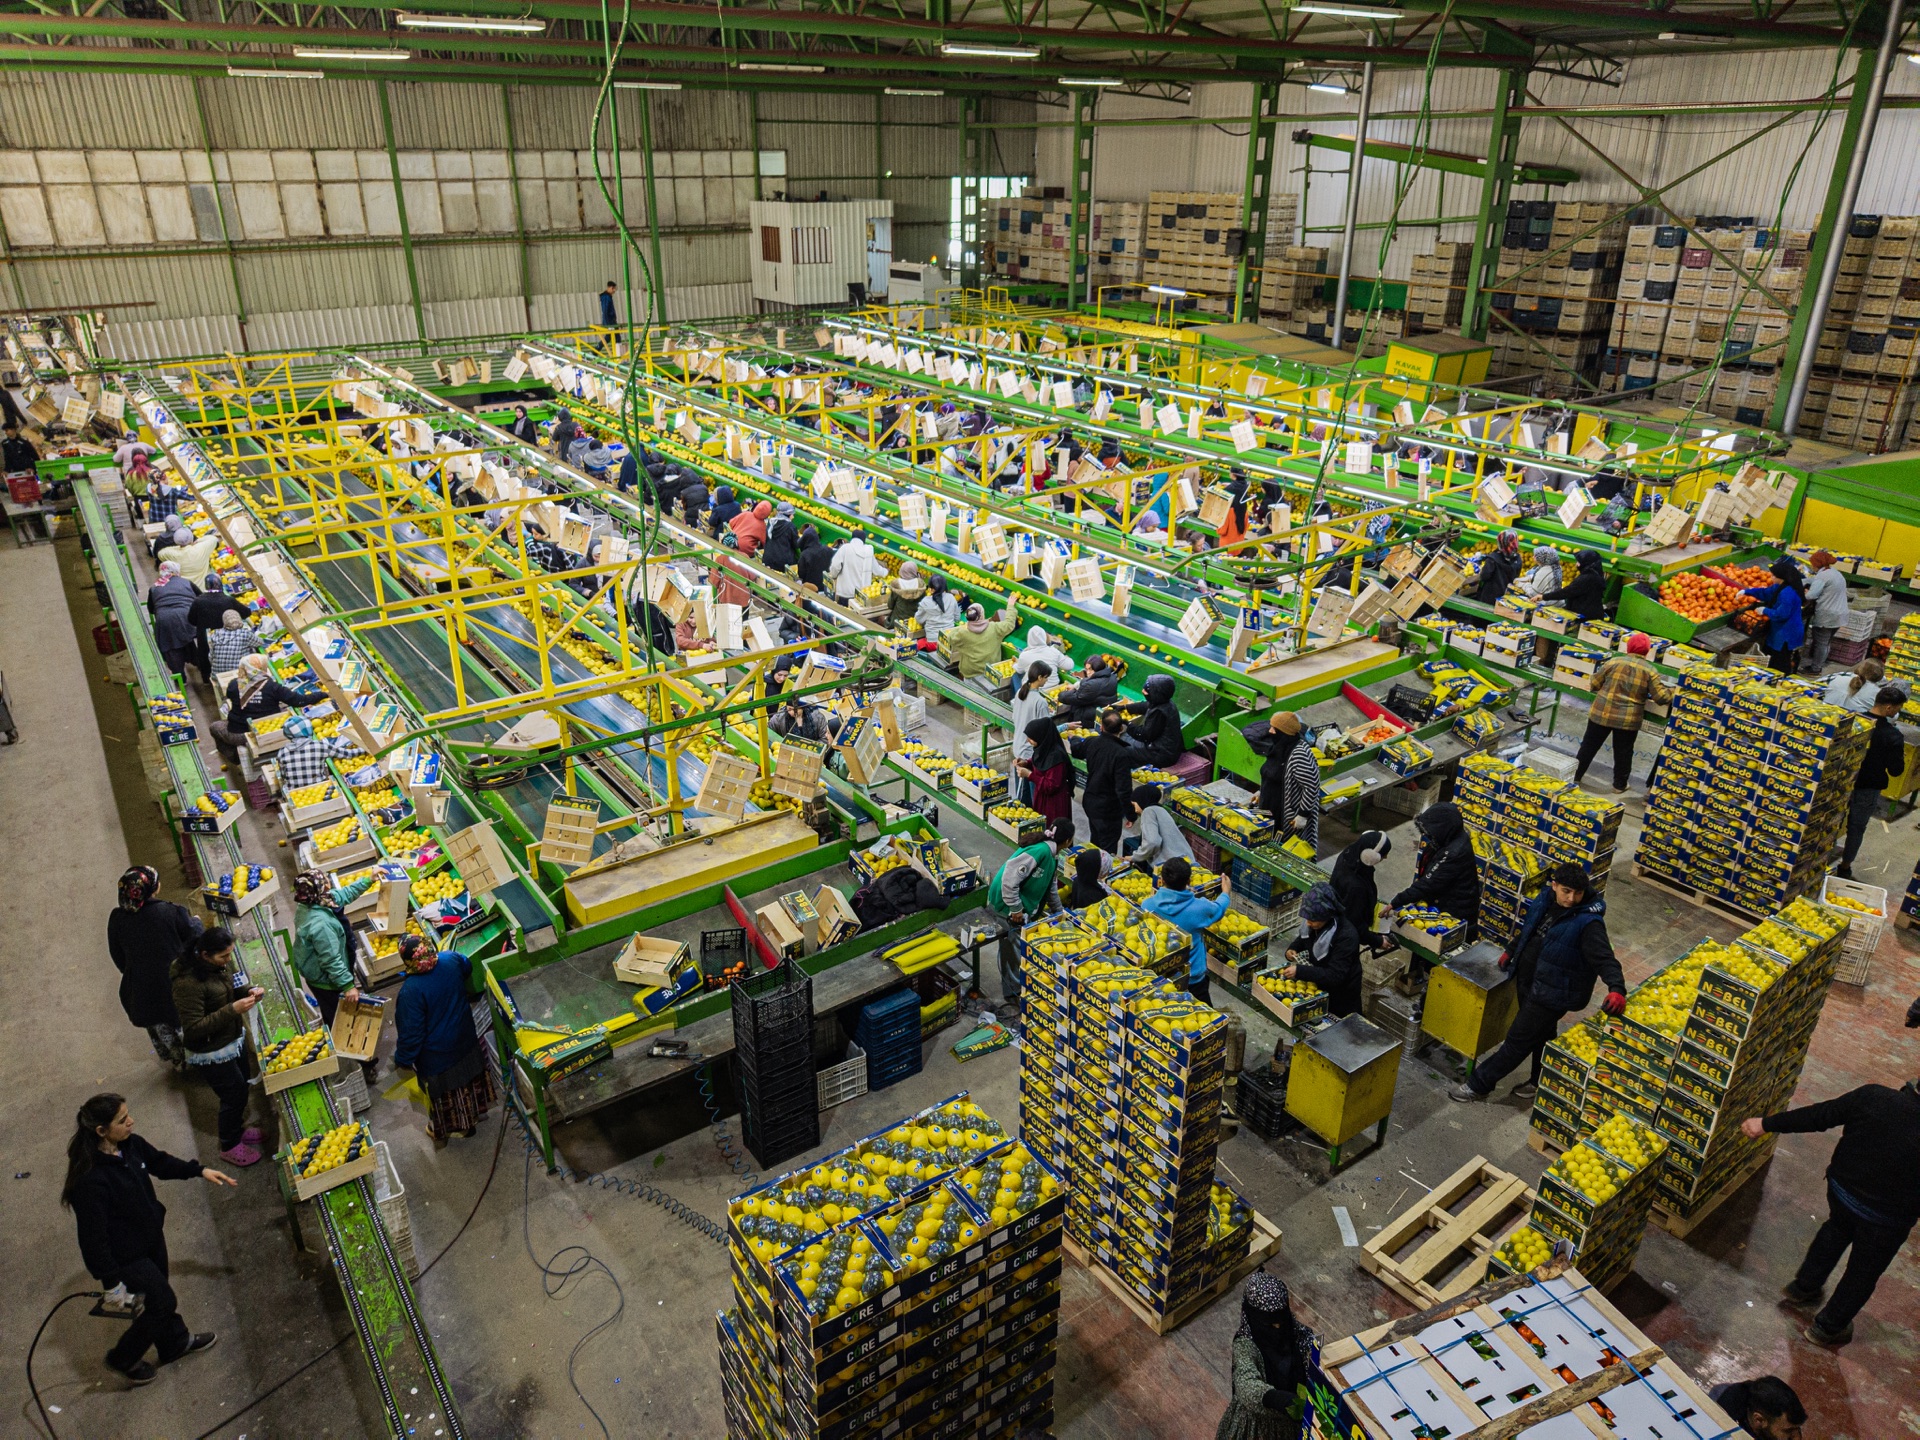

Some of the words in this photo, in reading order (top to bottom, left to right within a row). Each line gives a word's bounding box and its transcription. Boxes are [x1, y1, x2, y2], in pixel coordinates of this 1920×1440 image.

[1396, 360, 1421, 372] KAVAK
[1684, 676, 1719, 695] Povedo
[1680, 698, 1715, 716] Povedo
[1732, 695, 1770, 714] Povedo
[844, 719, 864, 746] Povedo
[1675, 719, 1710, 737] Povedo
[1728, 717, 1765, 737] Povedo
[1786, 713, 1825, 733] Povedo
[169, 732, 189, 742] CORE
[1453, 726, 1476, 745] Povedo
[1780, 735, 1818, 756] Povedo
[1670, 738, 1704, 757] Povedo
[1723, 738, 1760, 758] Povedo
[1383, 758, 1399, 772] CORE
[1665, 758, 1698, 777] Povedo
[1716, 758, 1752, 778] Povedo
[1774, 756, 1813, 777] Povedo
[1463, 769, 1496, 790] Povedo
[1661, 778, 1694, 797] Povedo
[1711, 776, 1747, 796] Povedo
[1766, 777, 1805, 798] Povedo
[982, 787, 1007, 797] Povedo
[1460, 787, 1491, 808] Povedo
[1508, 784, 1543, 806] Povedo
[1176, 803, 1200, 824] Povedo
[1504, 805, 1538, 827] Povedo
[1654, 797, 1688, 816] Povedo
[1706, 797, 1742, 817] Povedo
[1762, 798, 1799, 819] Povedo
[190, 821, 210, 831] CORE
[1557, 806, 1594, 829] Povedo
[1649, 816, 1683, 835] Povedo
[1701, 817, 1737, 837] Povedo
[1215, 822, 1242, 843] Povedo
[1501, 826, 1535, 847] Povedo
[1551, 824, 1588, 847] Povedo
[1755, 818, 1793, 839] Povedo
[1645, 835, 1678, 855] Povedo
[1696, 835, 1730, 855] Povedo
[1751, 839, 1788, 860] Povedo
[1640, 854, 1672, 874] Povedo
[1690, 855, 1724, 875] Povedo
[1744, 857, 1781, 878] Povedo
[1487, 868, 1517, 891] Povedo
[1686, 874, 1719, 894] Povedo
[1739, 875, 1776, 897] Povedo
[1483, 890, 1514, 912] Povedo
[1734, 894, 1770, 916] Povedo
[1479, 909, 1509, 932] Povedo
[1153, 955, 1182, 973] ovedo
[1134, 1019, 1177, 1057] Povedo
[1191, 1039, 1224, 1060] Povedo
[1133, 1050, 1175, 1088] Povedo
[1188, 1071, 1222, 1096] Povedo
[1184, 1099, 1218, 1124] Povedo
[1129, 1135, 1169, 1174] Poveo
[1126, 1162, 1165, 1201] Poveo
[1071, 1197, 1098, 1225] Poved
[1123, 1188, 1162, 1227] Poveo
[1069, 1221, 1097, 1252] Poved
[1120, 1240, 1157, 1279] Poveo
[1118, 1264, 1155, 1304] Poveo
